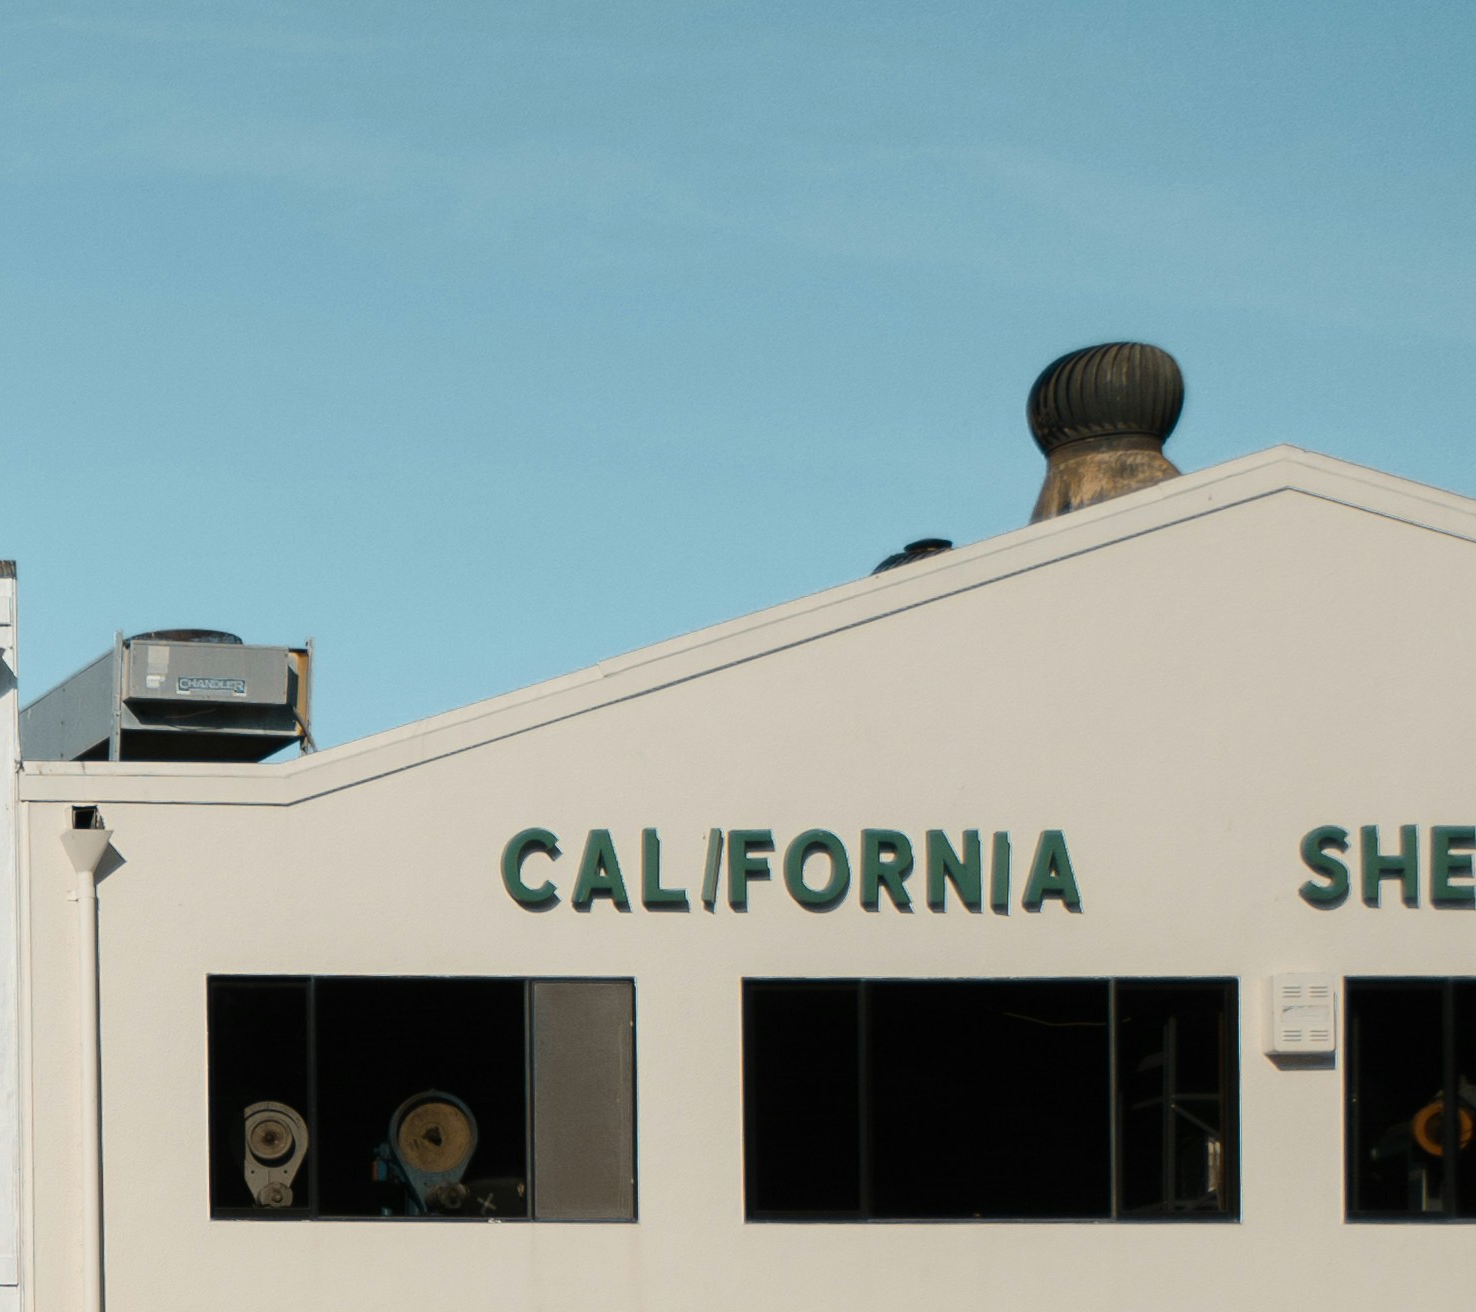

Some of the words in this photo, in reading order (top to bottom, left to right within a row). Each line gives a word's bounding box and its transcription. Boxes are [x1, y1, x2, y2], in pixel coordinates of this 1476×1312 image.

[180, 678, 244, 689] CHANDLER
[500, 827, 1084, 915] CALIFORNIA
[1298, 825, 1476, 910] SHE
